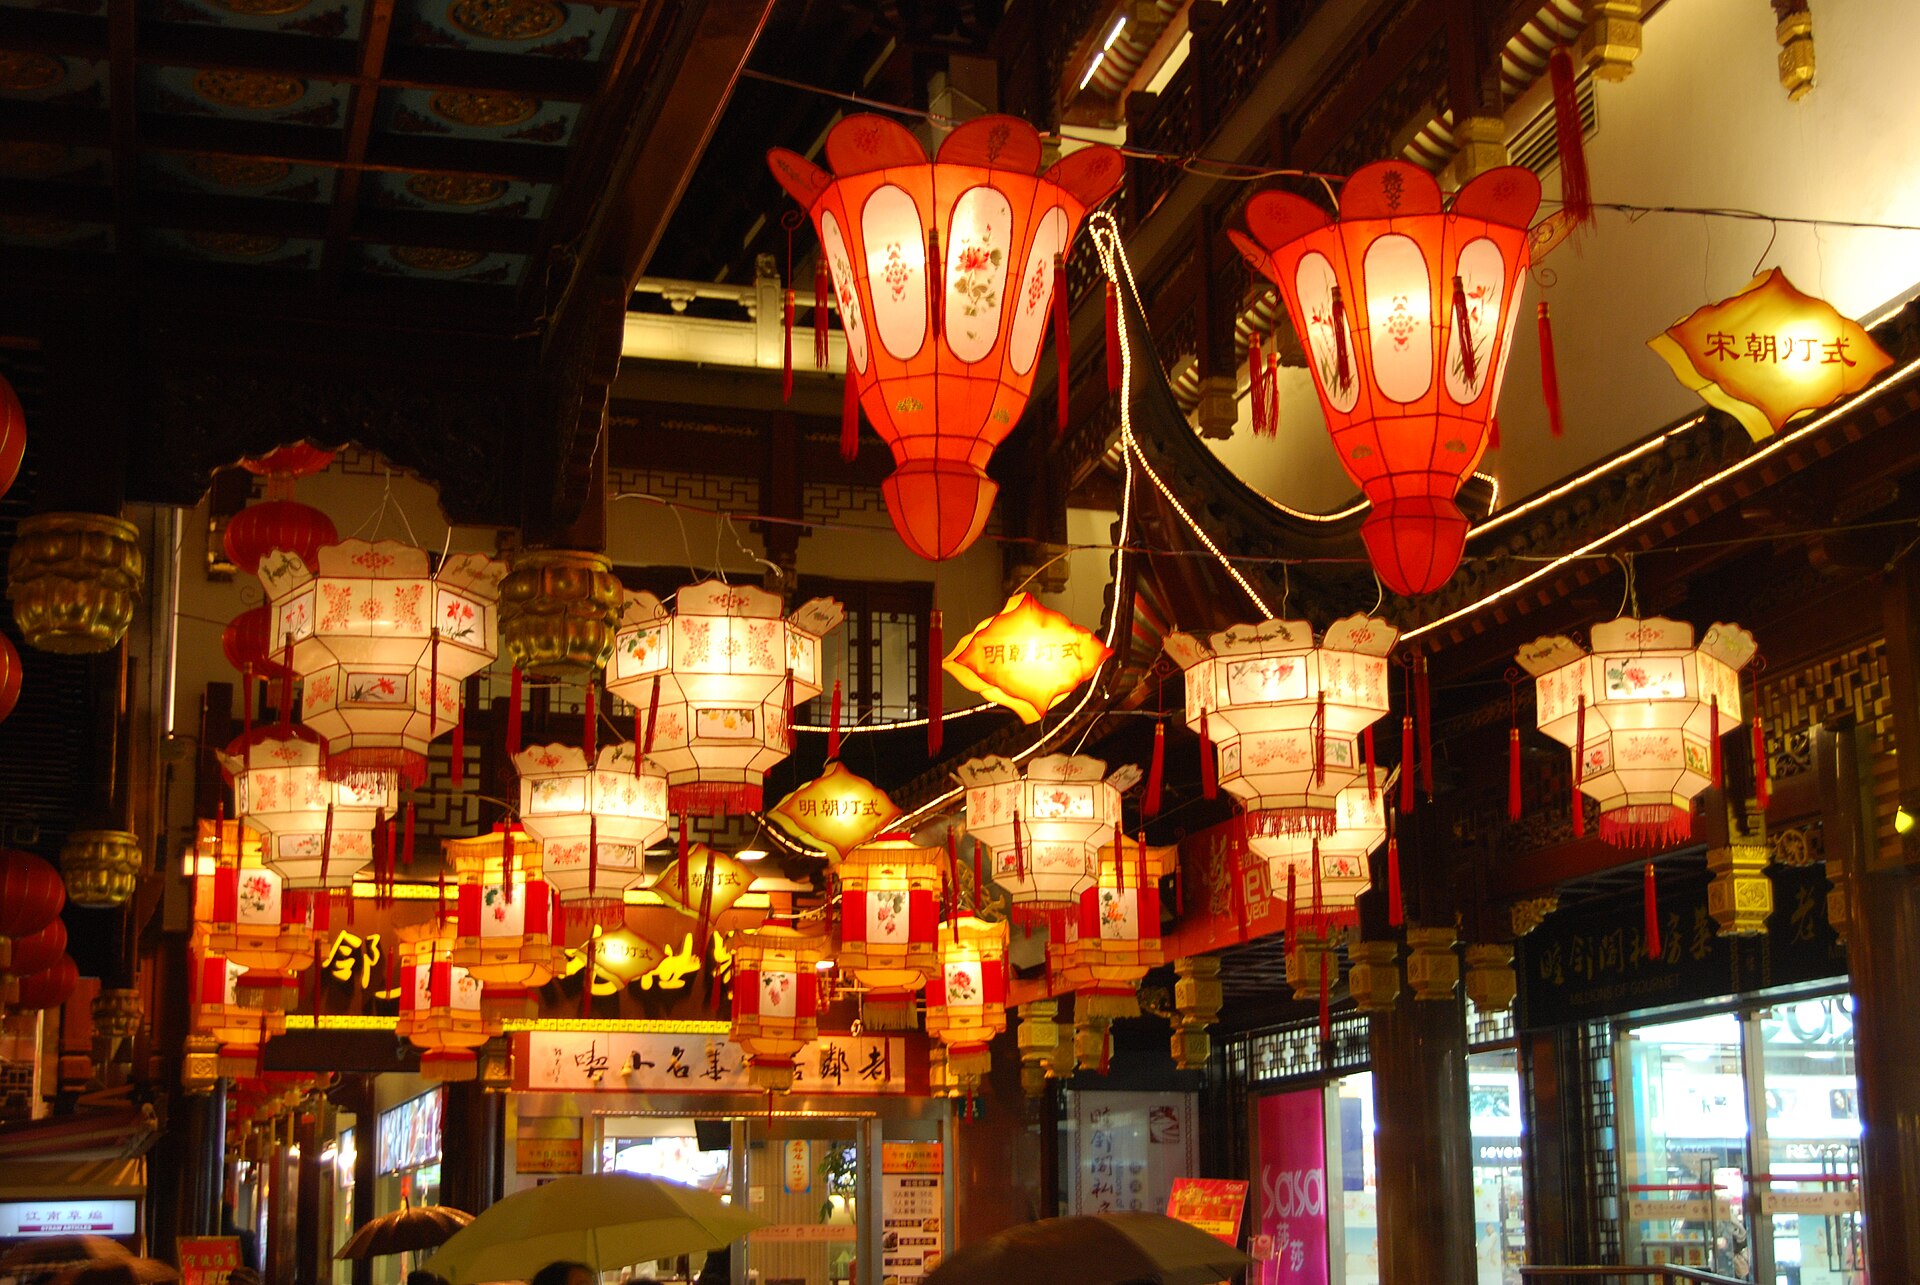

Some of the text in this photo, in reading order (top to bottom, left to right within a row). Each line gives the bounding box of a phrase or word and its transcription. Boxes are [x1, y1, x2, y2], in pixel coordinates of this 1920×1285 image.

[1704, 331, 1857, 368] 宋朝灯式
[798, 798, 882, 817] 明朝灯式
